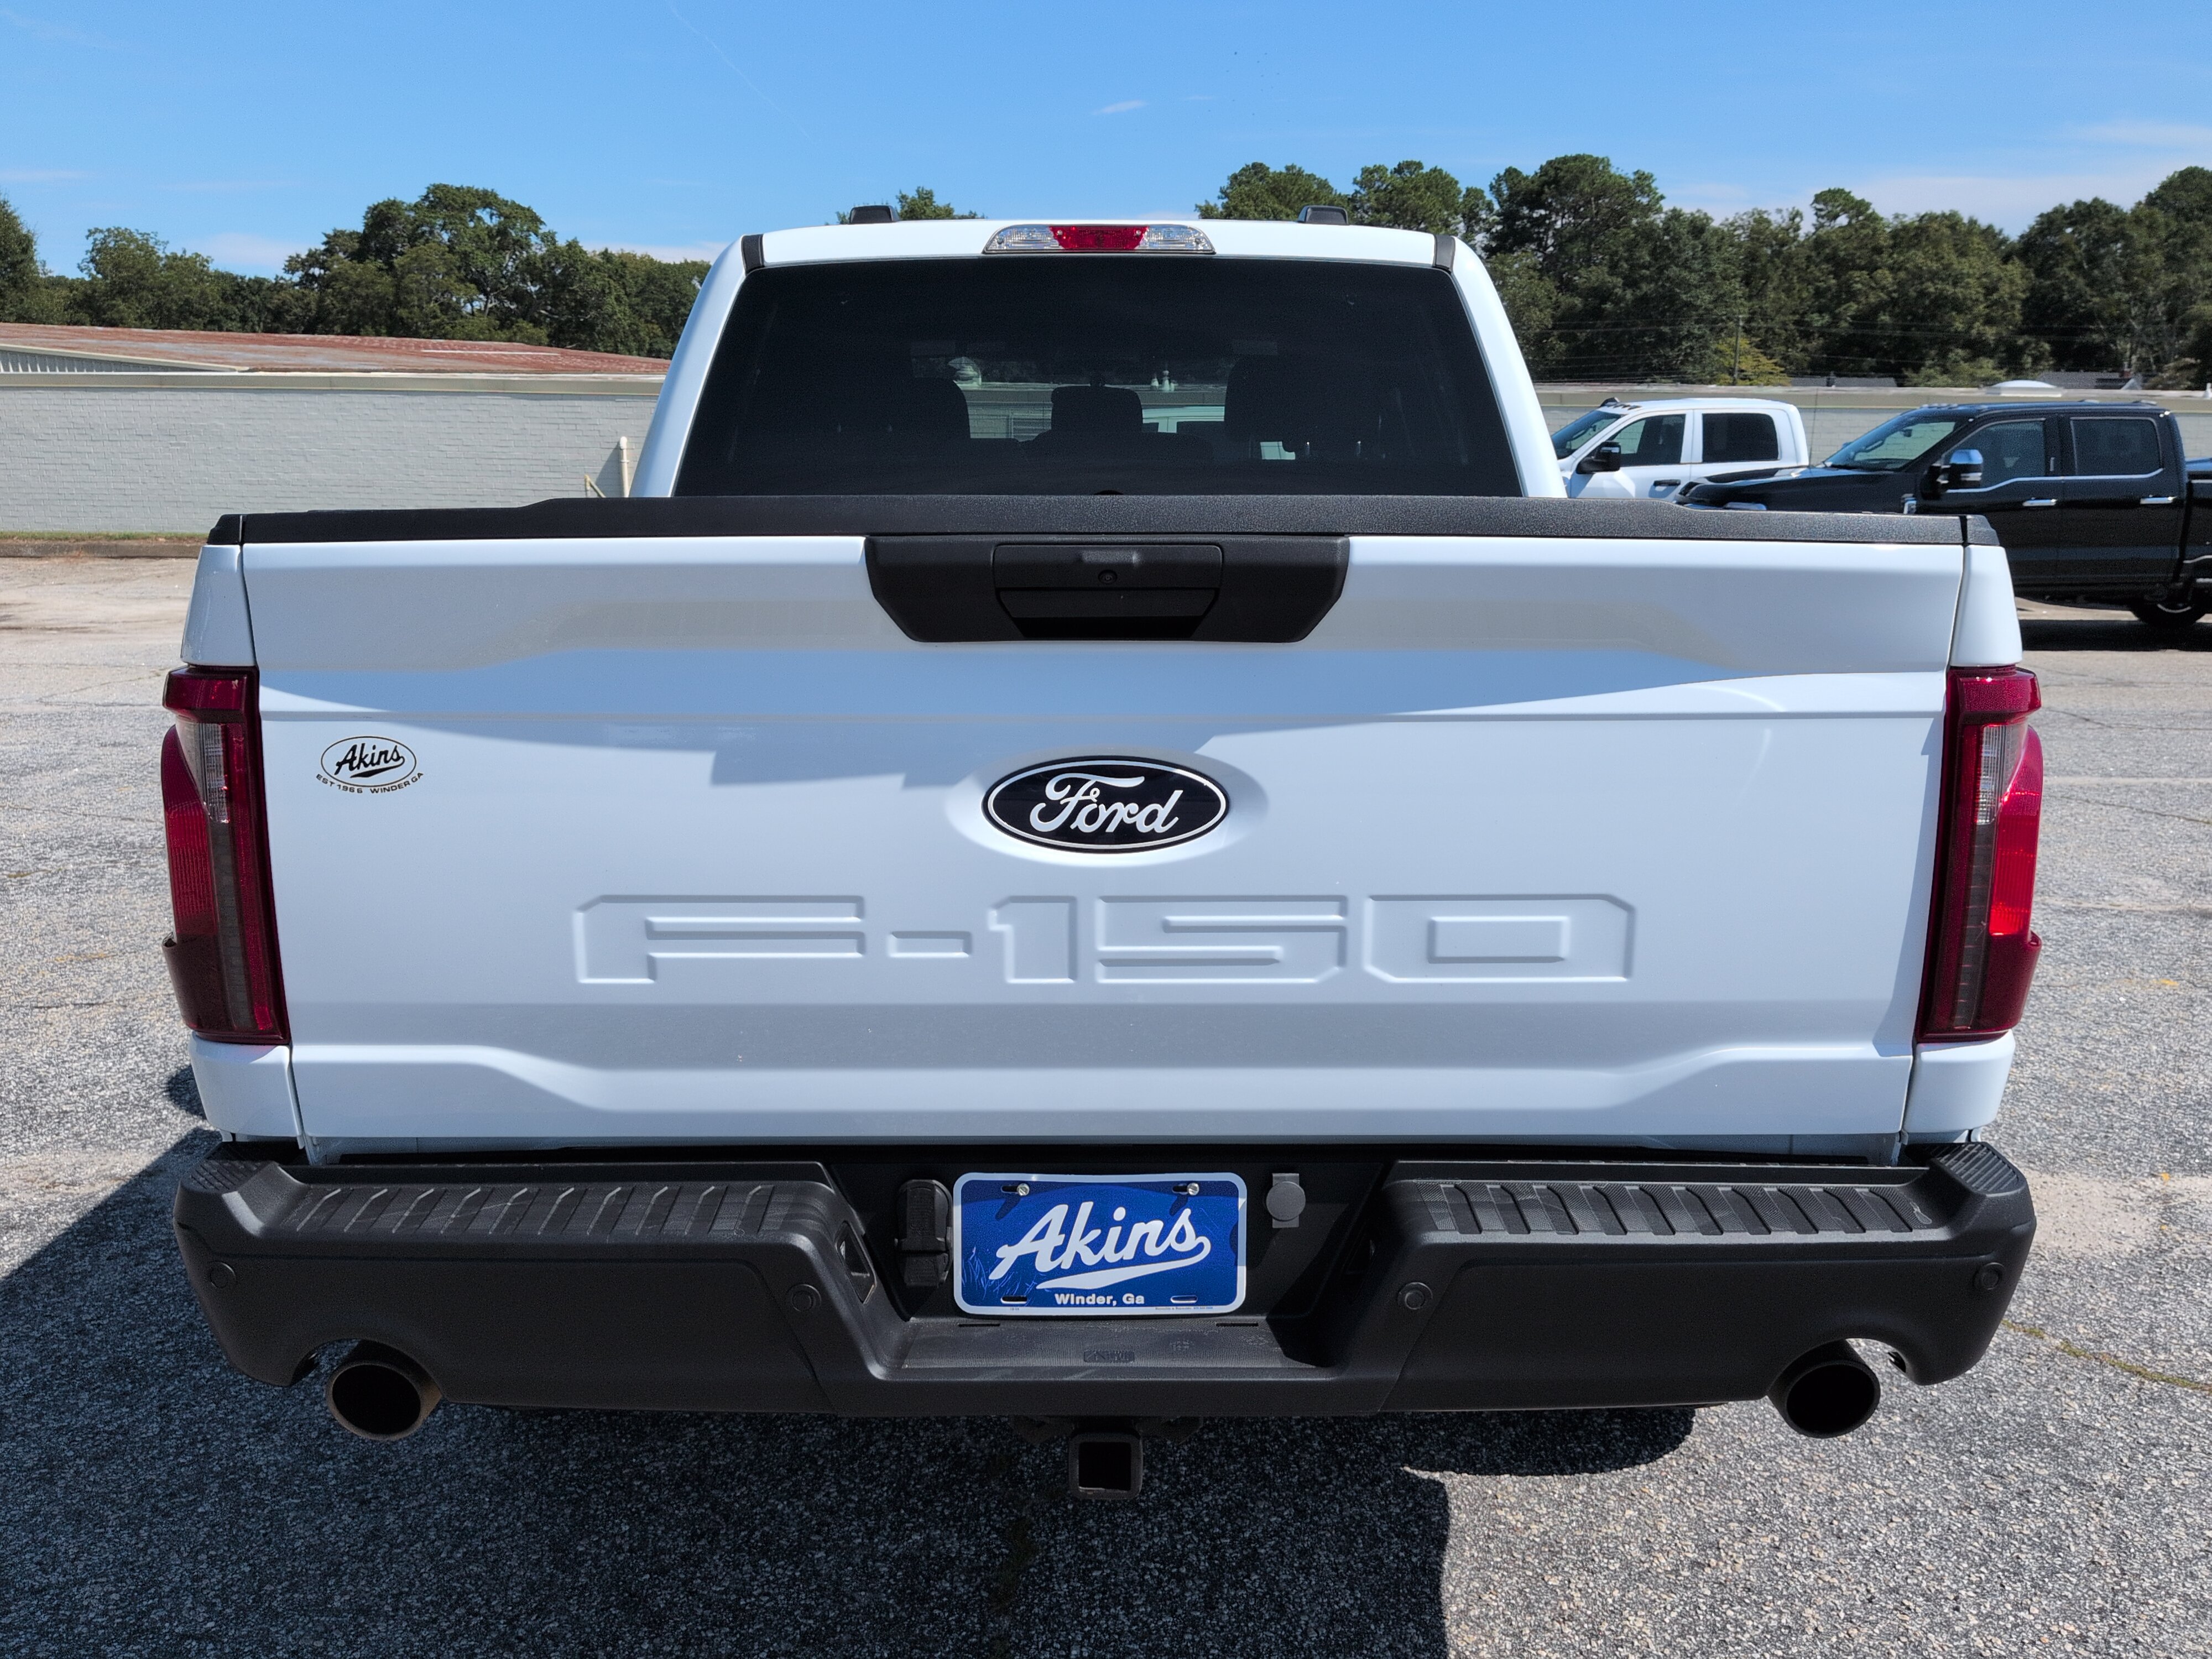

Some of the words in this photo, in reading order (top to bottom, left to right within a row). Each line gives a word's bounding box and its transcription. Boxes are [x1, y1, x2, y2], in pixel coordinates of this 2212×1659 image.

[316, 774, 335, 787] EST
[337, 784, 363, 794] 1966
[370, 780, 410, 794] WINDER
[411, 772, 424, 783] GA
[334, 743, 405, 778] Akins
[1030, 773, 1183, 833] Ford
[572, 894, 1636, 984] F-150
[989, 1201, 1212, 1290] Akins
[1054, 1293, 1117, 1306] Winder,
[1122, 1293, 1145, 1305] Ga
